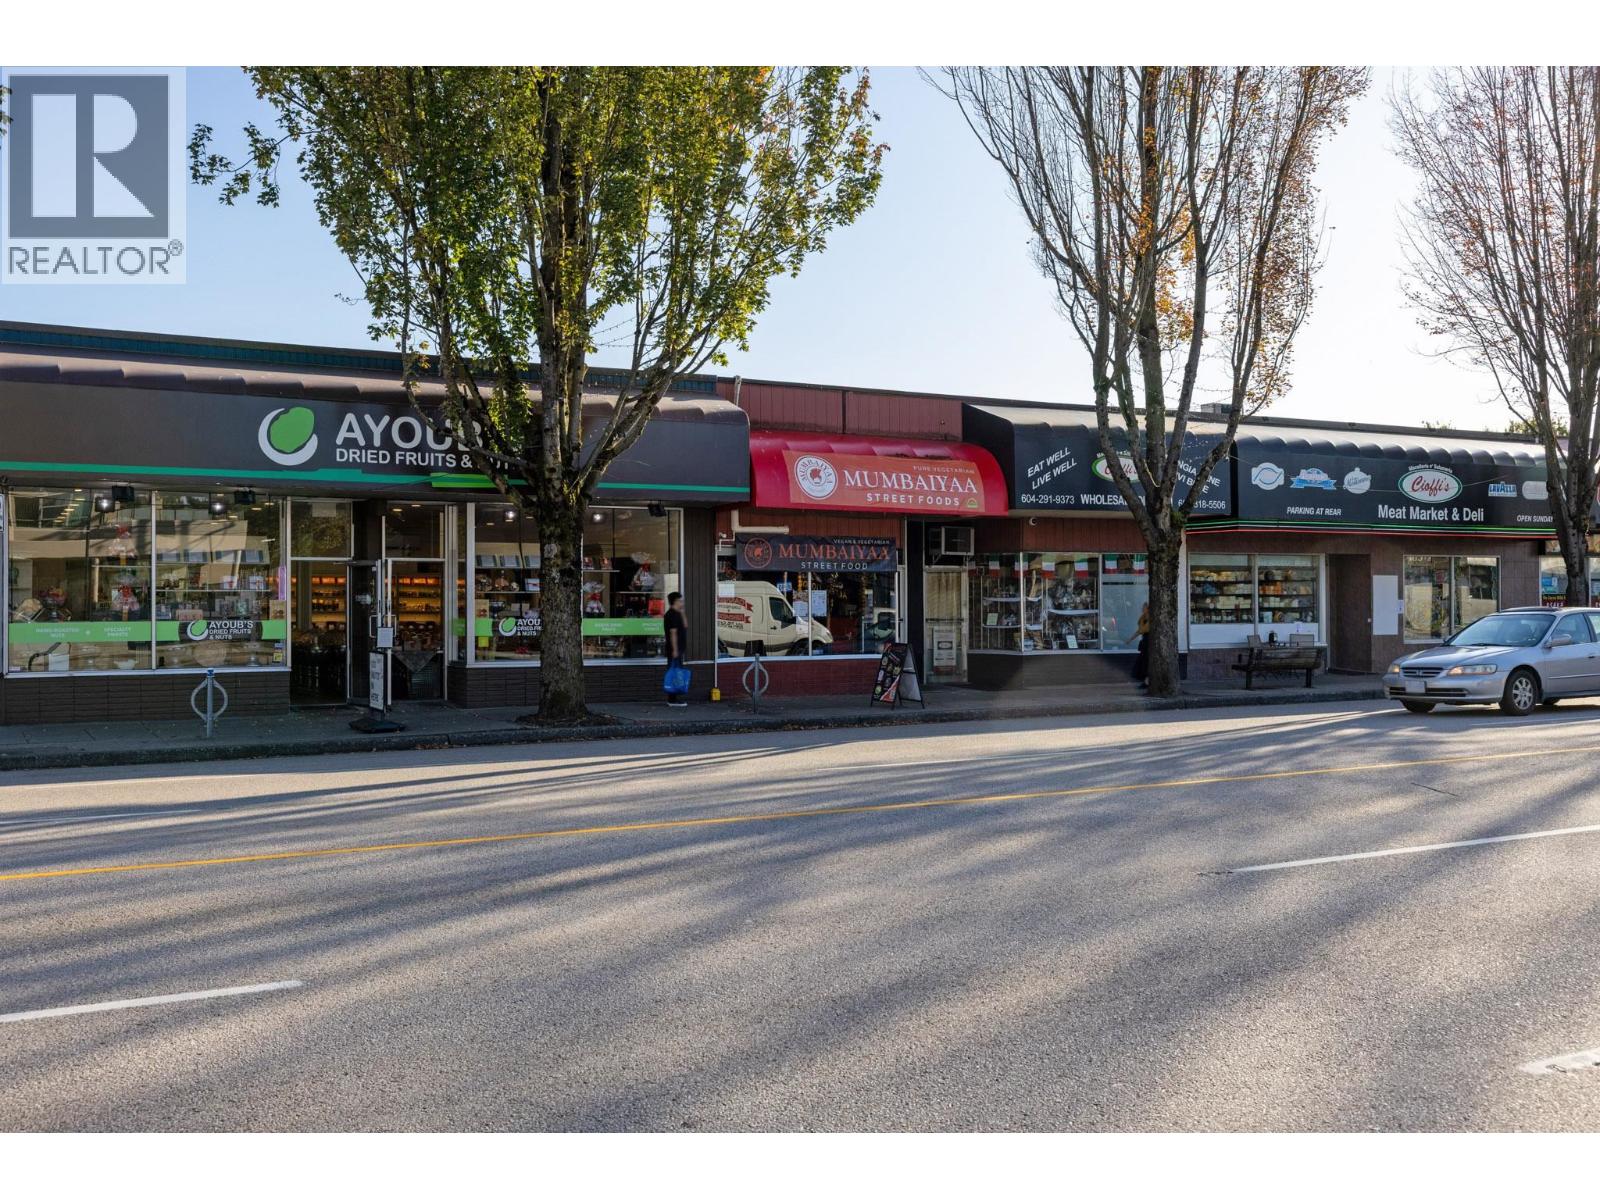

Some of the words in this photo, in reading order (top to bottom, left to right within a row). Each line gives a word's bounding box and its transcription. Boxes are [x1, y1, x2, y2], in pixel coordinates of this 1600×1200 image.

[336, 449, 390, 464] DRIED
[395, 452, 456, 467] FRUITS
[461, 454, 473, 468] &
[1027, 459, 1045, 477] EAT
[1046, 447, 1071, 466] WELL
[1032, 470, 1051, 490] LIVE
[1051, 458, 1077, 480] WELL
[1178, 460, 1197, 476] NGIA
[844, 470, 978, 493] MUMBAIYAA
[1411, 475, 1450, 497] Cioffi's
[867, 493, 914, 503] STREET
[919, 495, 960, 506] FOODS
[1021, 493, 1075, 504] 604-291-9373
[1081, 494, 1128, 505] WHOLESA
[1287, 506, 1315, 515] PARKING
[1316, 507, 1324, 515] AT
[1325, 508, 1341, 516] REAR
[1378, 504, 1407, 519] Meat
[1410, 506, 1449, 520] Market
[1452, 507, 1460, 521] &
[1463, 508, 1484, 521] Deli
[779, 544, 891, 560] MUMBAIYAA
[841, 562, 868, 570] FOOD
[209, 620, 254, 629] AYOUB'S
